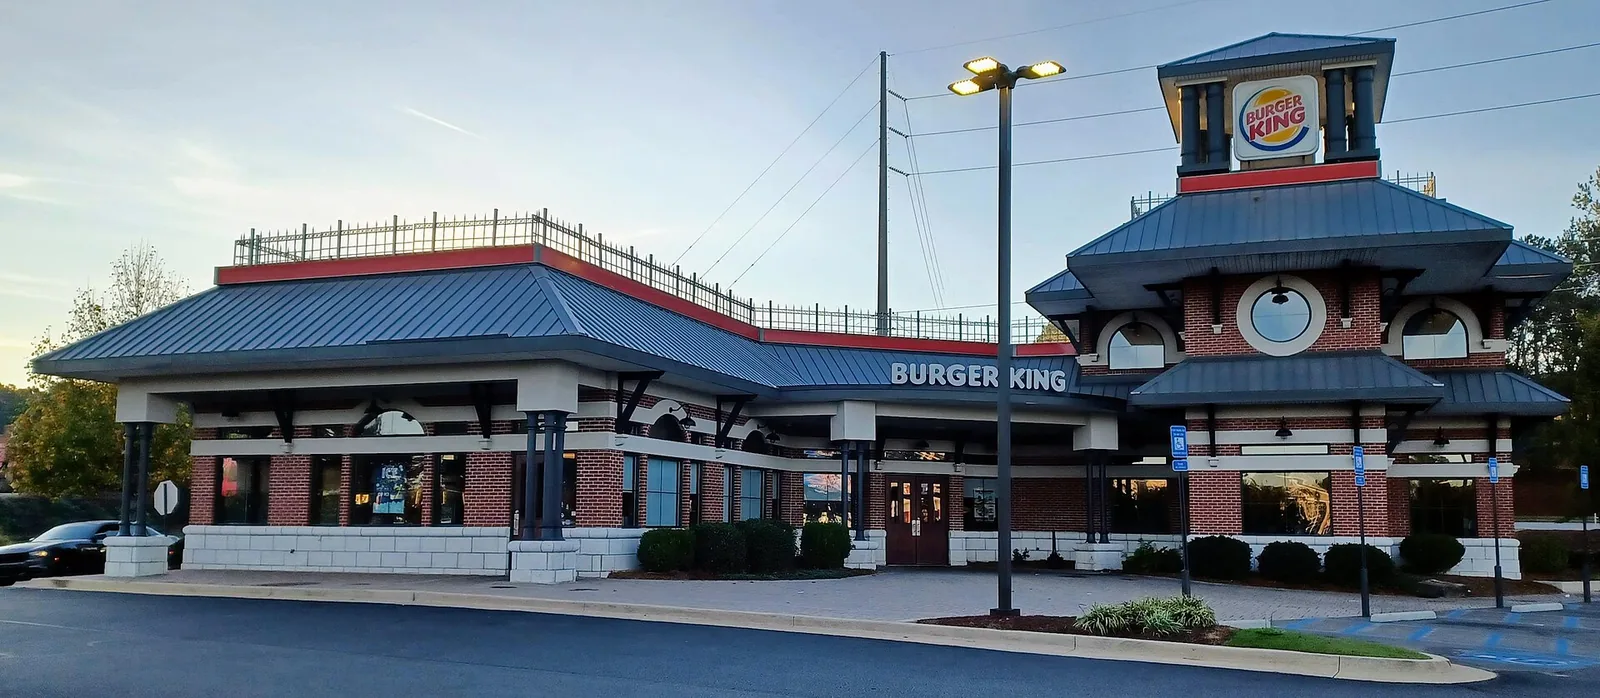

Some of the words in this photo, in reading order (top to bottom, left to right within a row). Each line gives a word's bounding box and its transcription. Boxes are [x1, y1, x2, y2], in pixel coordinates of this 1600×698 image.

[1246, 95, 1303, 125] BURGER
[1249, 106, 1305, 141] KING
[891, 362, 999, 388] BURGER
[1009, 367, 1066, 392] KING
